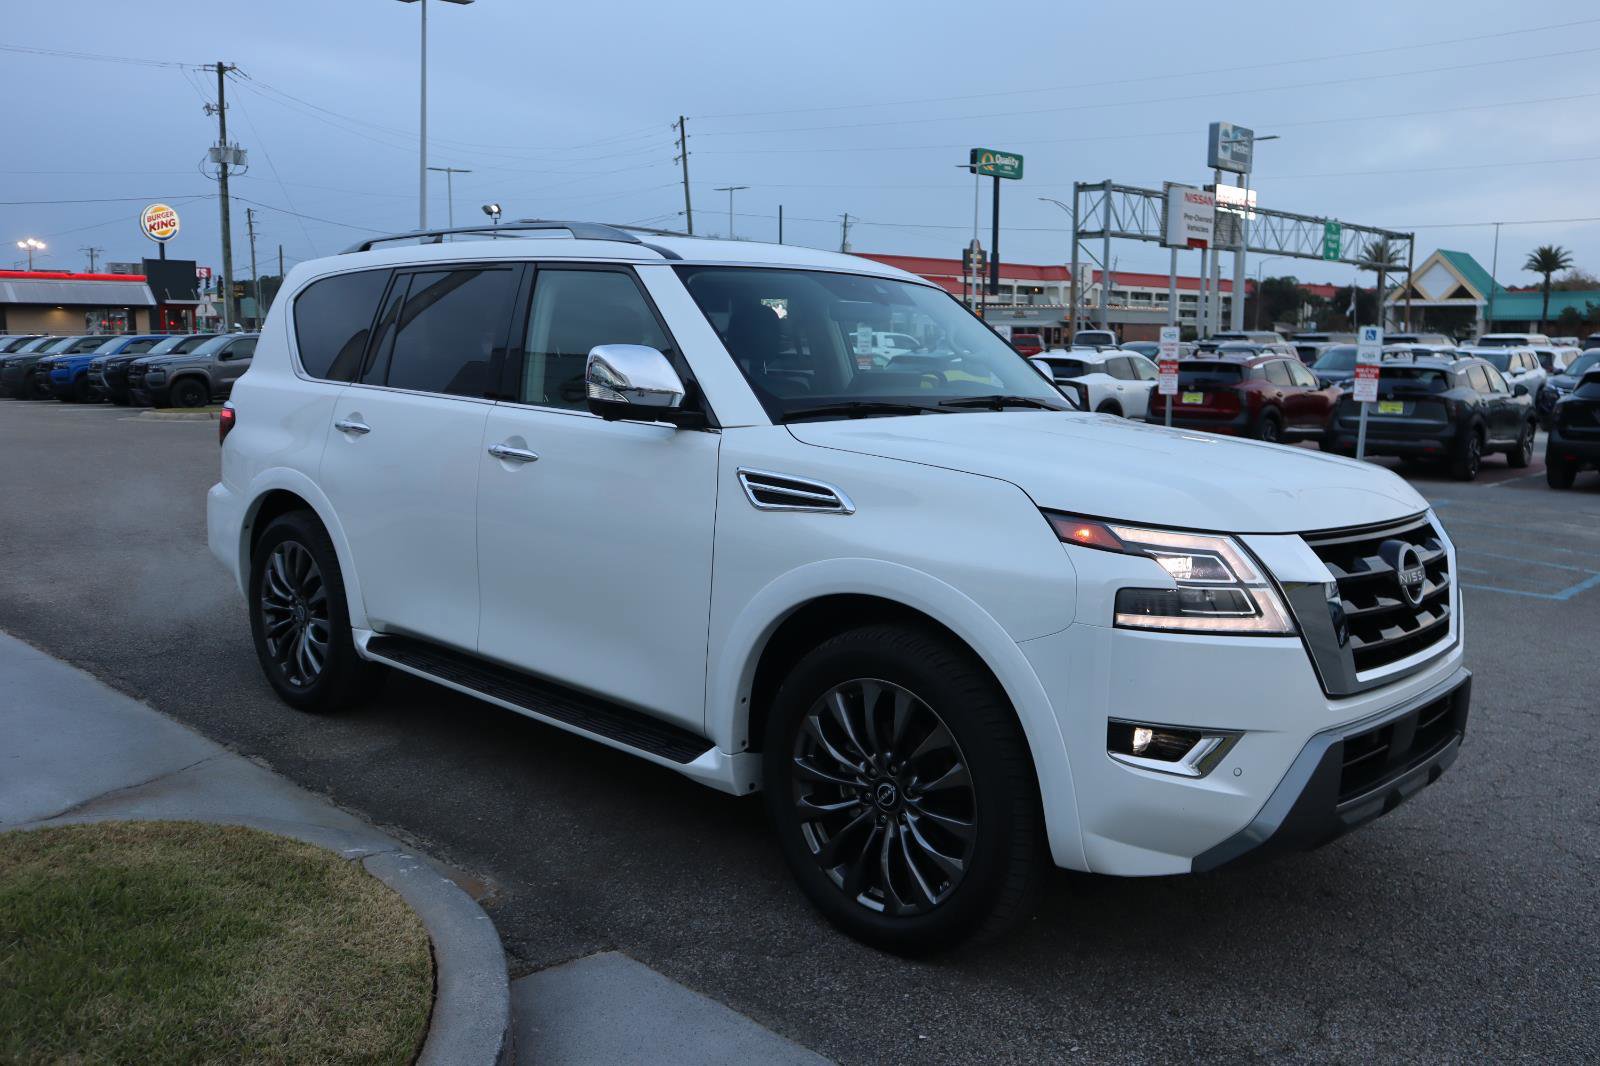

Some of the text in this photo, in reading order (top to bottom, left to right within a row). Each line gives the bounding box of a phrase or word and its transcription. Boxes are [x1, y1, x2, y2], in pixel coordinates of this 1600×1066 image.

[1184, 192, 1213, 206] NISSAN
[147, 211, 174, 223] BURGER
[149, 219, 176, 232] KING
